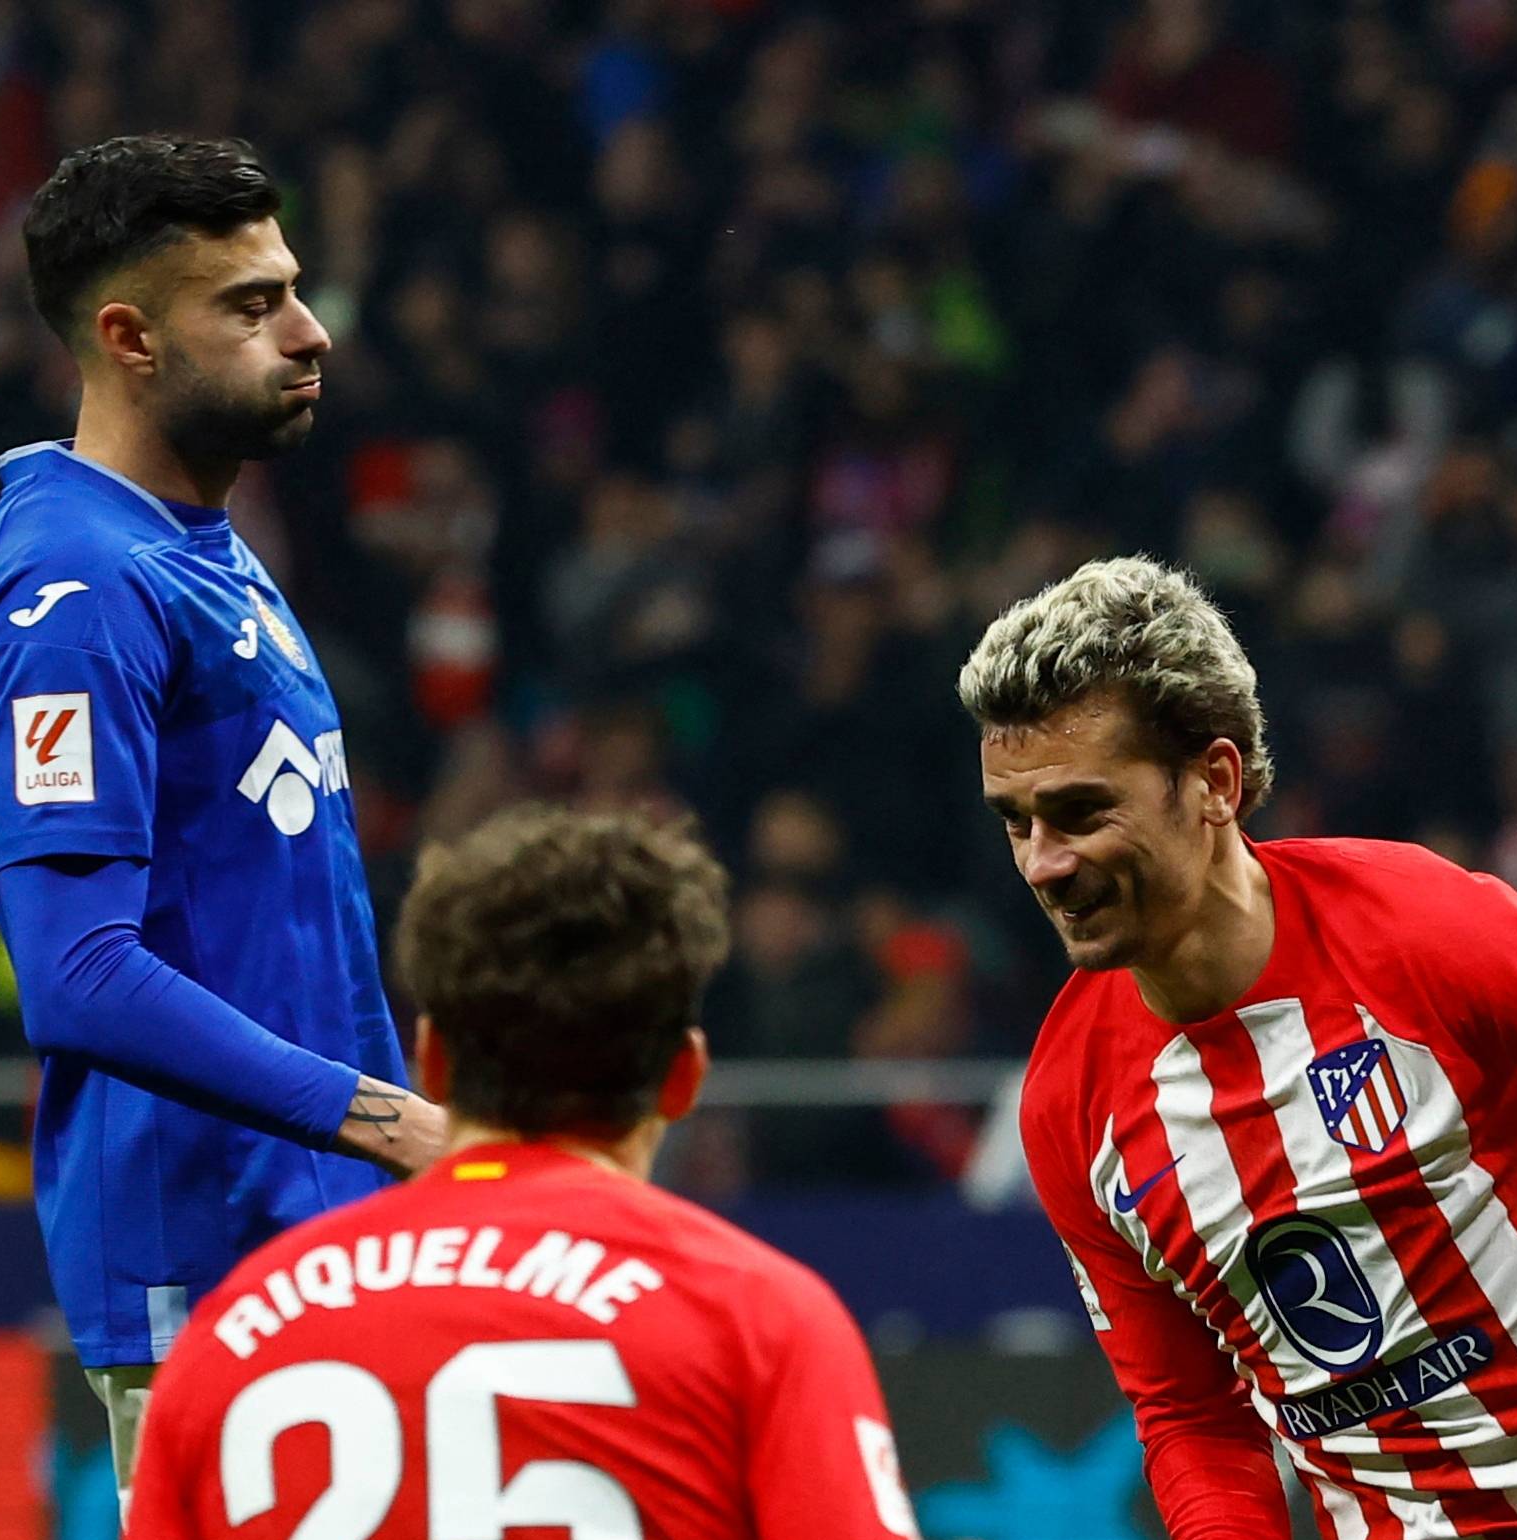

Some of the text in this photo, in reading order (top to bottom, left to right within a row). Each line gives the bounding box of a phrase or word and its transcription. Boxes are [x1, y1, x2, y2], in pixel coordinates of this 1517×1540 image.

[25, 771, 83, 790] LALIGA
[214, 1226, 664, 1360] RIQUELME
[1280, 1335, 1488, 1437] RIYADH AIR
